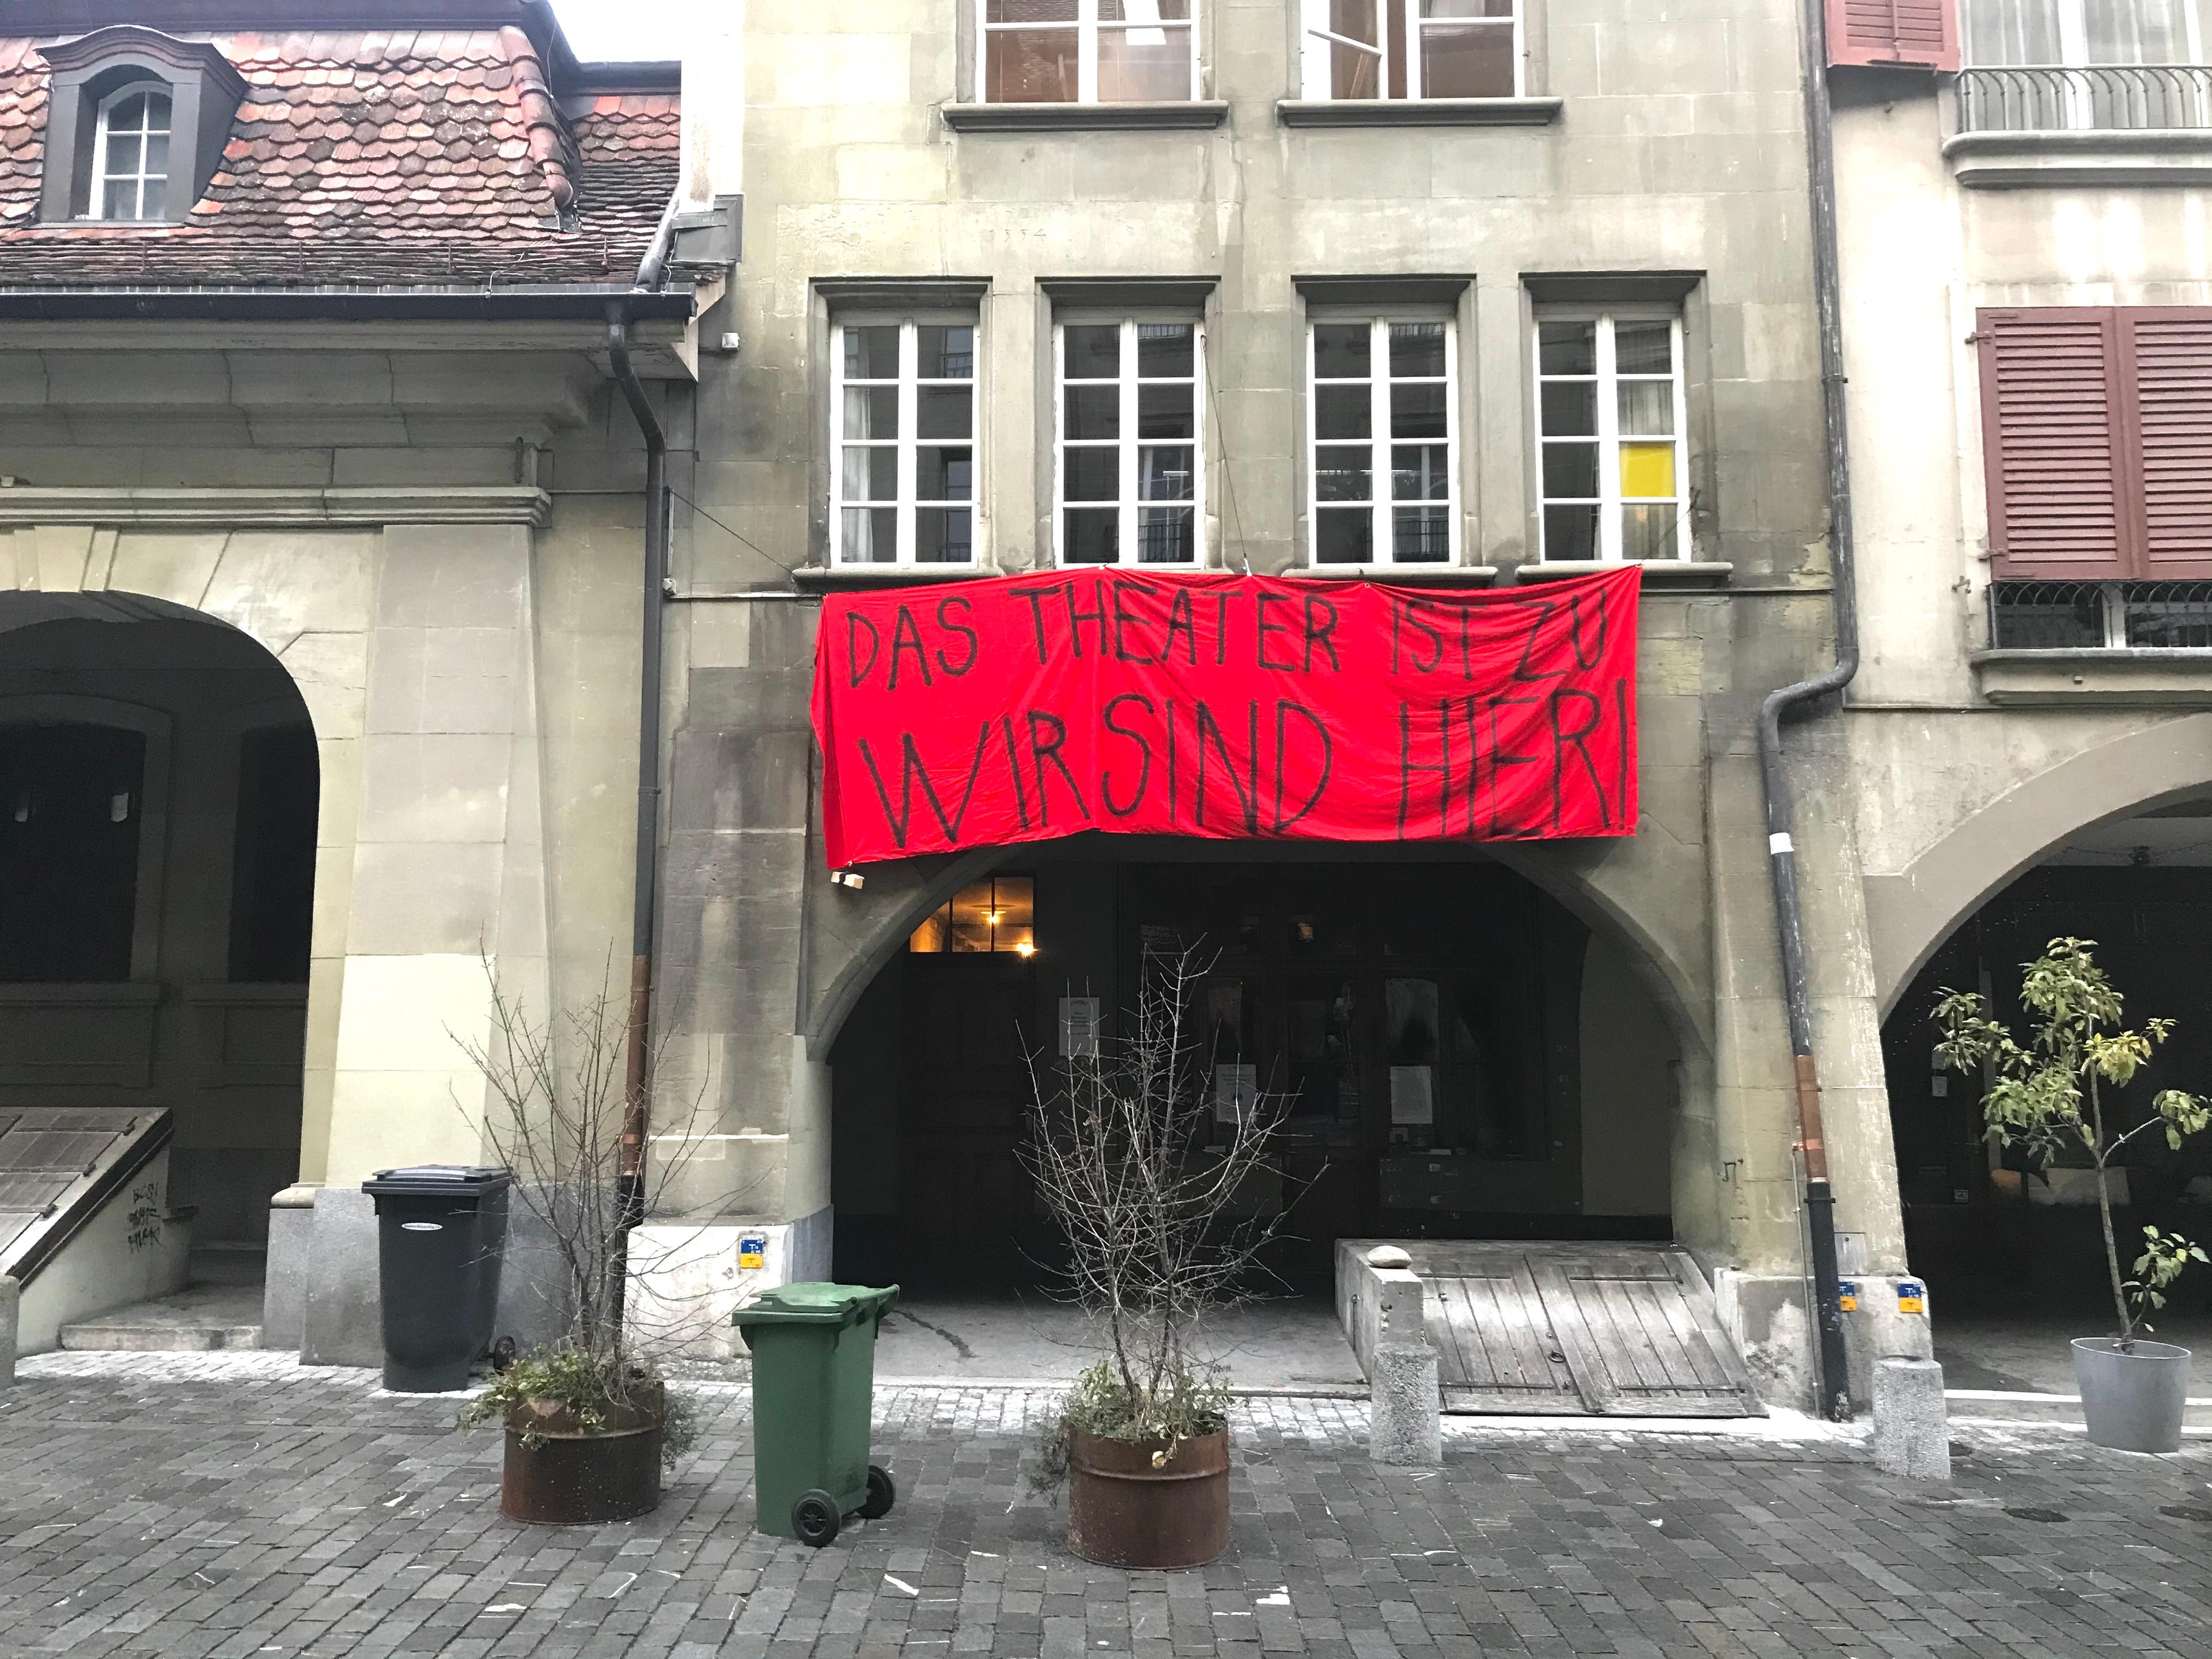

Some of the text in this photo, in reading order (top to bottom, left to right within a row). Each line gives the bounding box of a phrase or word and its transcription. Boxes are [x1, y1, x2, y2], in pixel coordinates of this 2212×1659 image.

[846, 578, 1606, 691] DAS THEATER IST ZU
[858, 678, 1627, 848] WIR SIND HIER!
